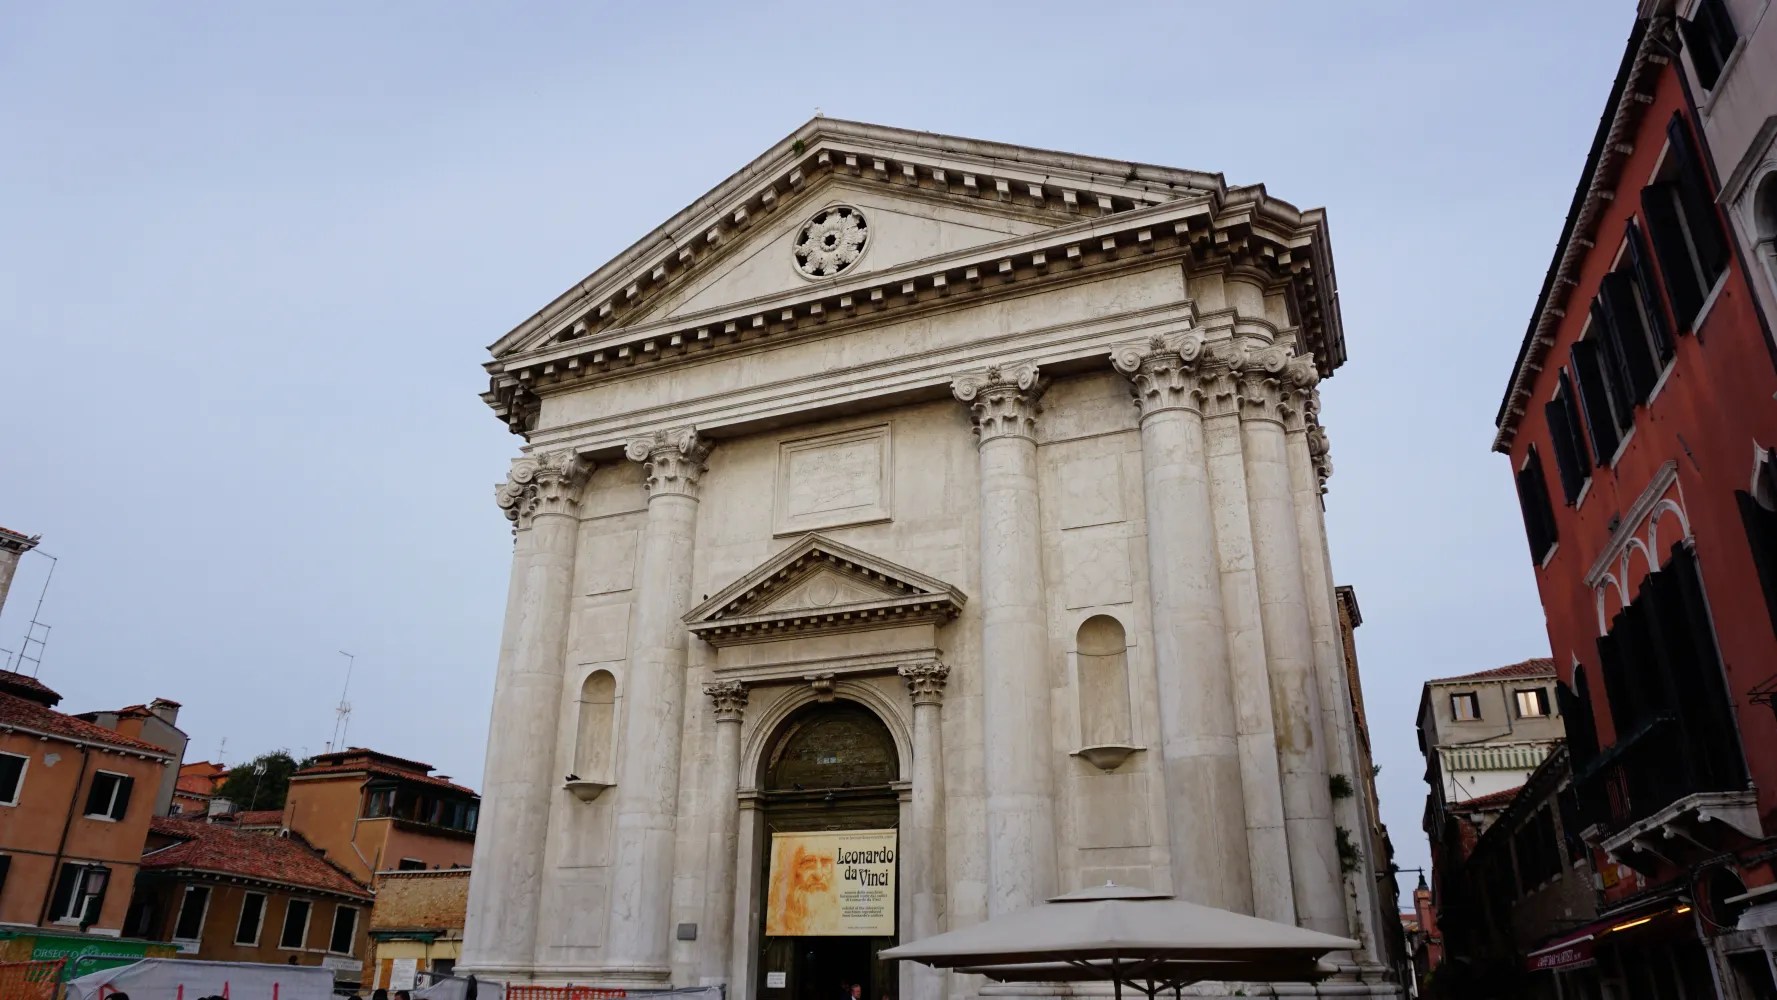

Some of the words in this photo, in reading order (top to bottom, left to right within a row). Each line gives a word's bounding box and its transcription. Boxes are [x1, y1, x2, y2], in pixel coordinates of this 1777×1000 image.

[837, 846, 893, 864] Leonardo
[845, 866, 857, 880] da
[859, 869, 888, 886] Vinci
